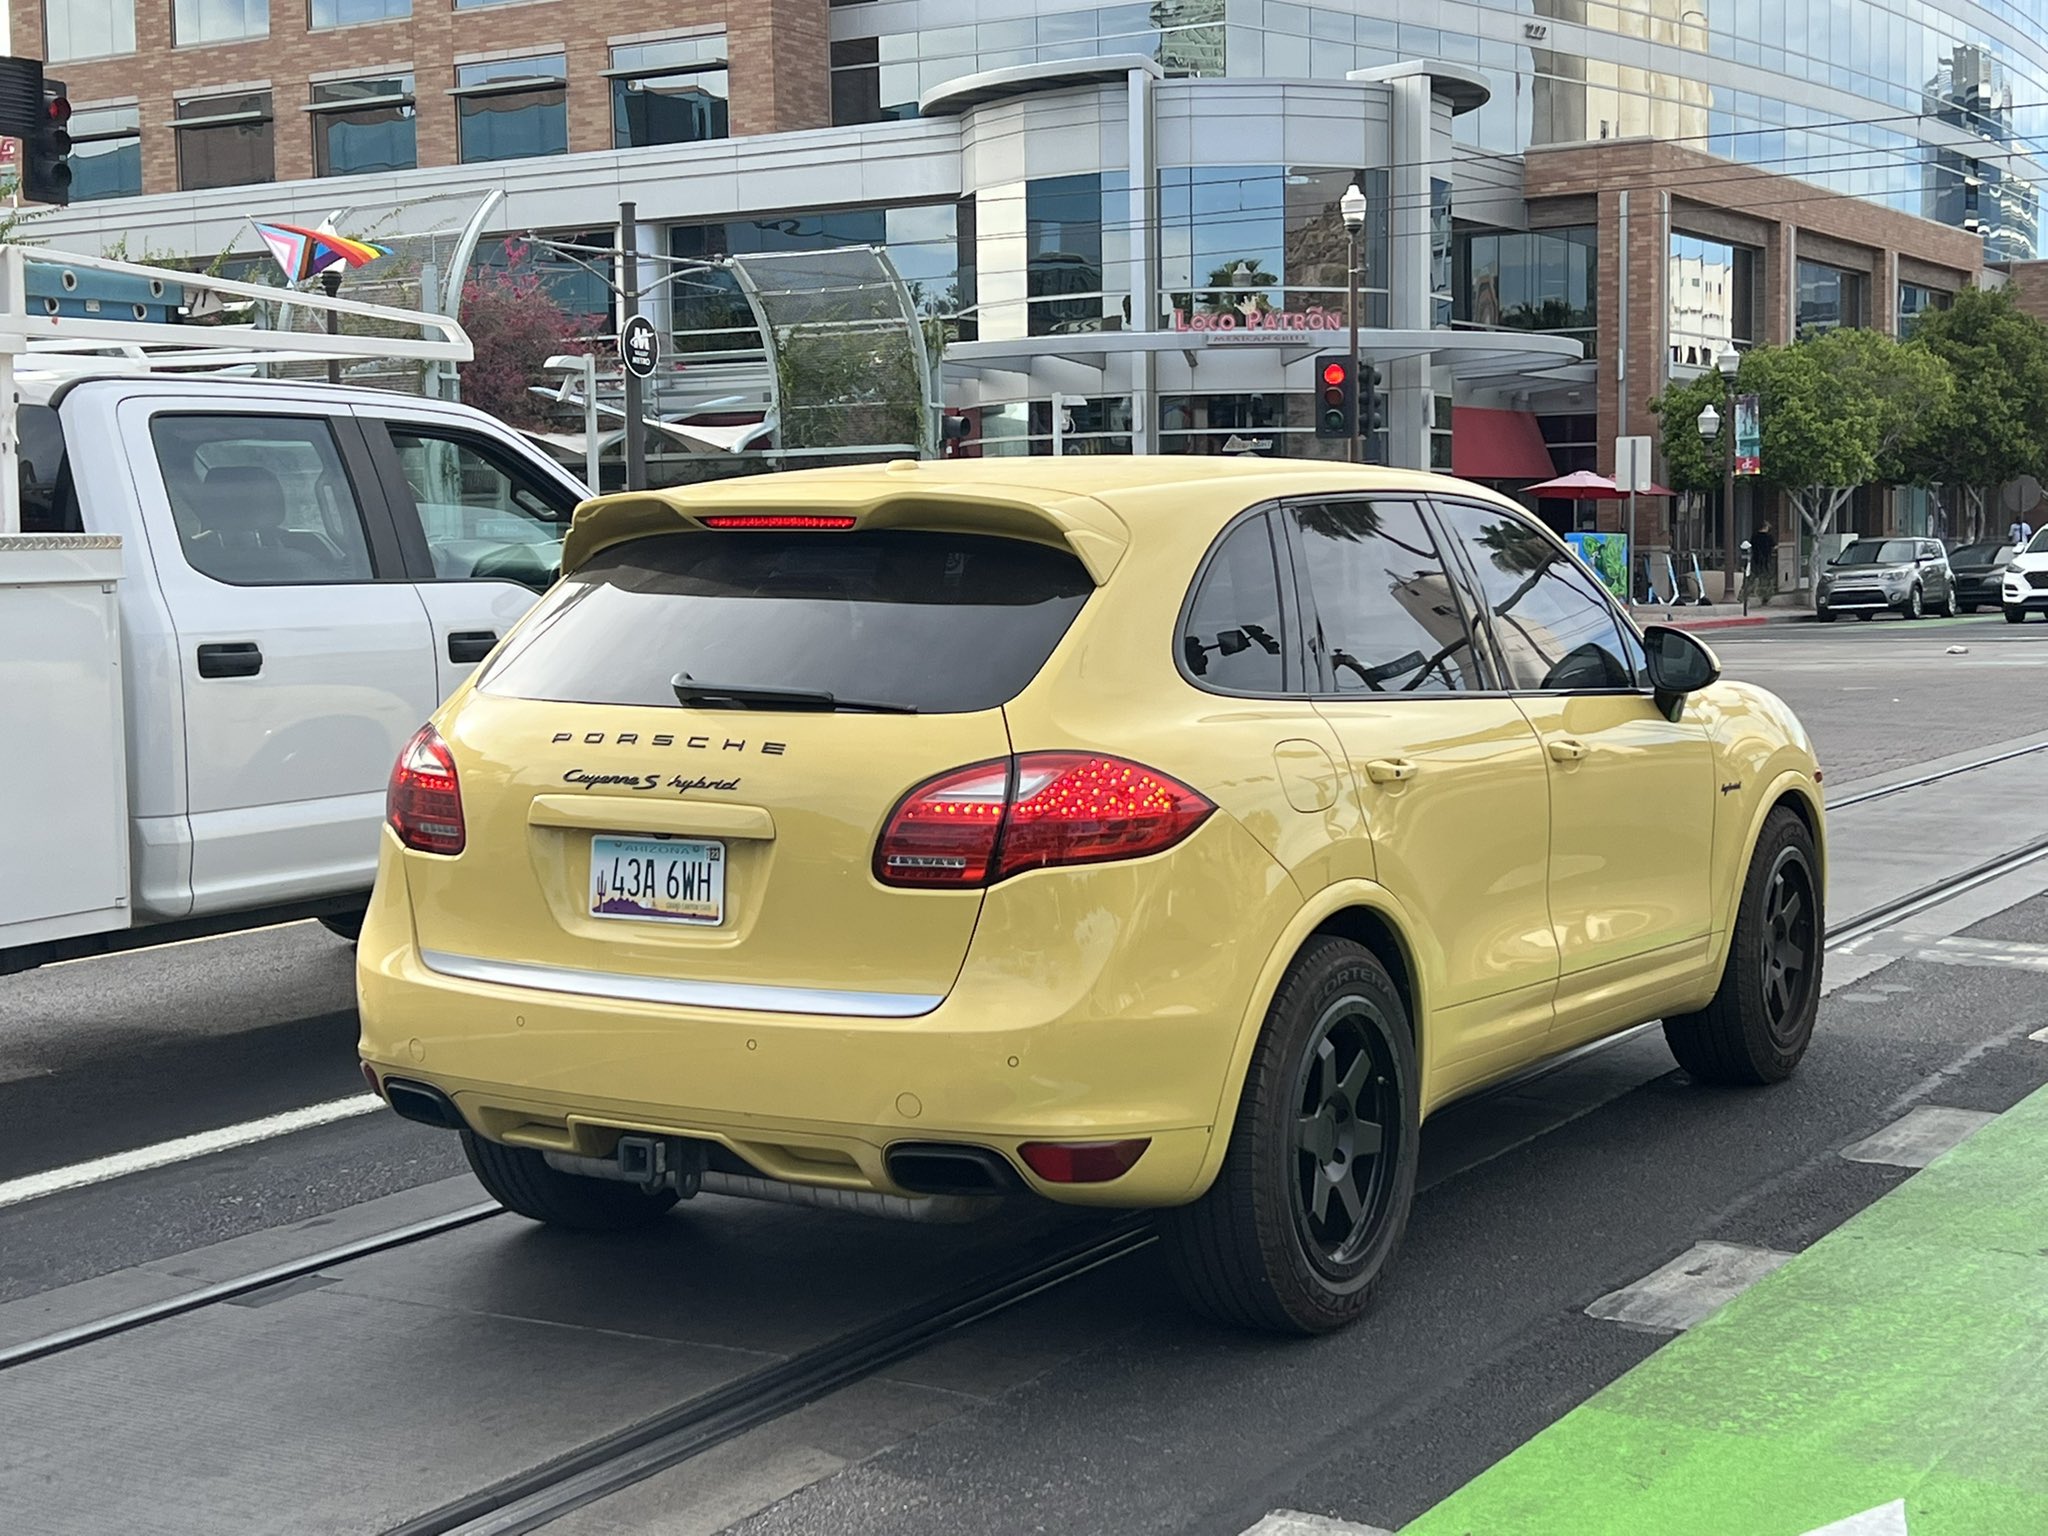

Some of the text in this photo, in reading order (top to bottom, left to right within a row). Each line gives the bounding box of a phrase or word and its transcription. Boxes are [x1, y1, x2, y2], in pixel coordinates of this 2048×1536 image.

[1174, 308, 1236, 332] LOCO
[551, 732, 786, 755] PORSCHE
[563, 769, 741, 794] Cayenne S hybrid
[624, 845, 690, 855] ARIZONA
[612, 857, 712, 902] 43A 6WH
